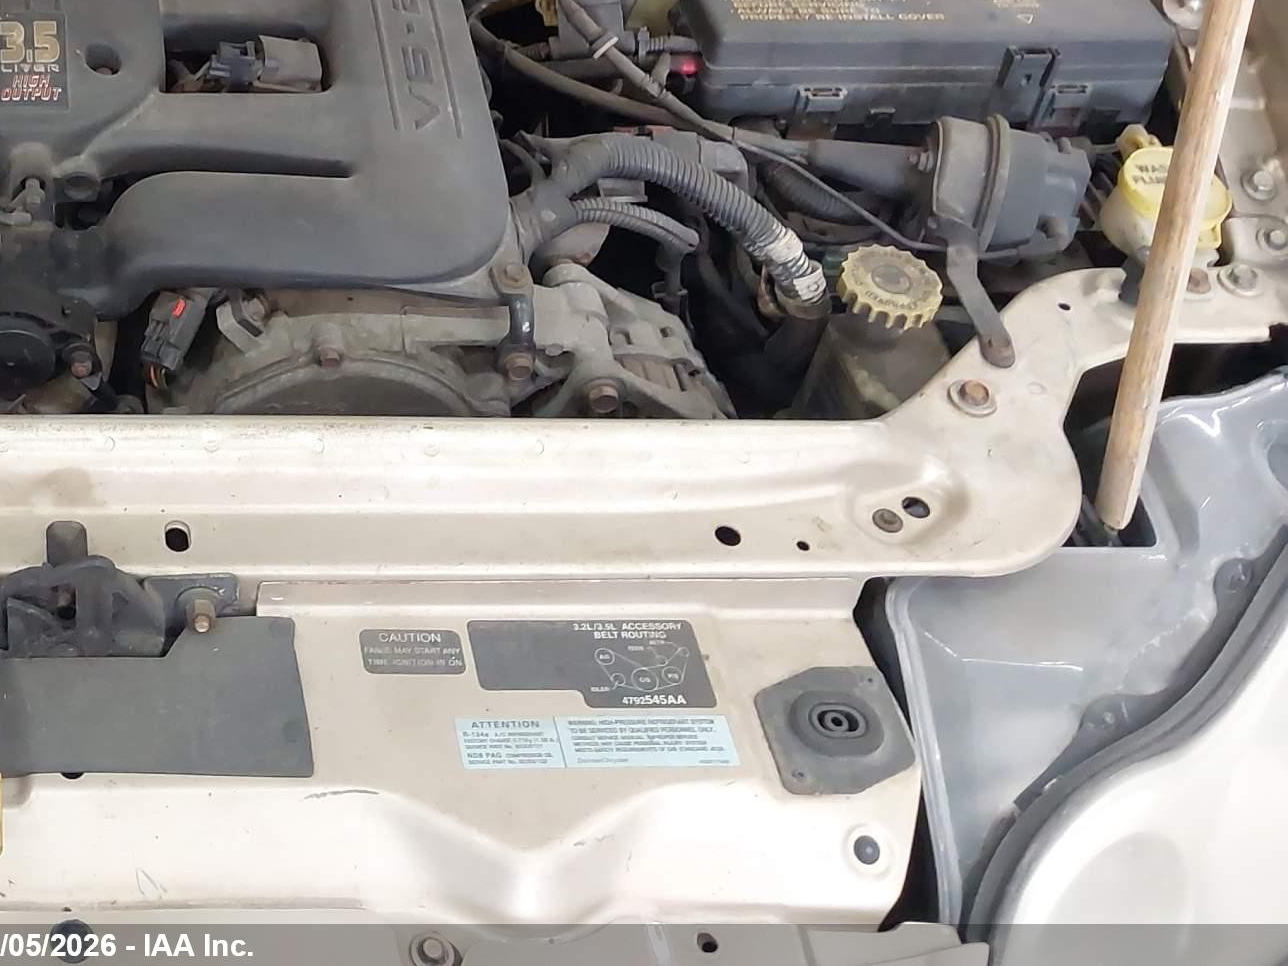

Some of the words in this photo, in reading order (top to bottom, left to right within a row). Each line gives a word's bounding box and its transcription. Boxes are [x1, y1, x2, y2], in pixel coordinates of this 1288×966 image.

[0, 20, 60, 64] 3.5
[12, 75, 50, 88] HIGH
[0, 88, 62, 101] OUTPUT
[622, 623, 682, 631] ACCESSORY
[378, 633, 441, 642] CAUTION
[594, 631, 618, 639] BELT
[621, 631, 667, 639] ROUTING
[392, 658, 434, 666] IGNITION
[448, 658, 463, 666] ON
[622, 694, 687, 705] 4792545AA
[472, 720, 540, 728] ATTENTION
